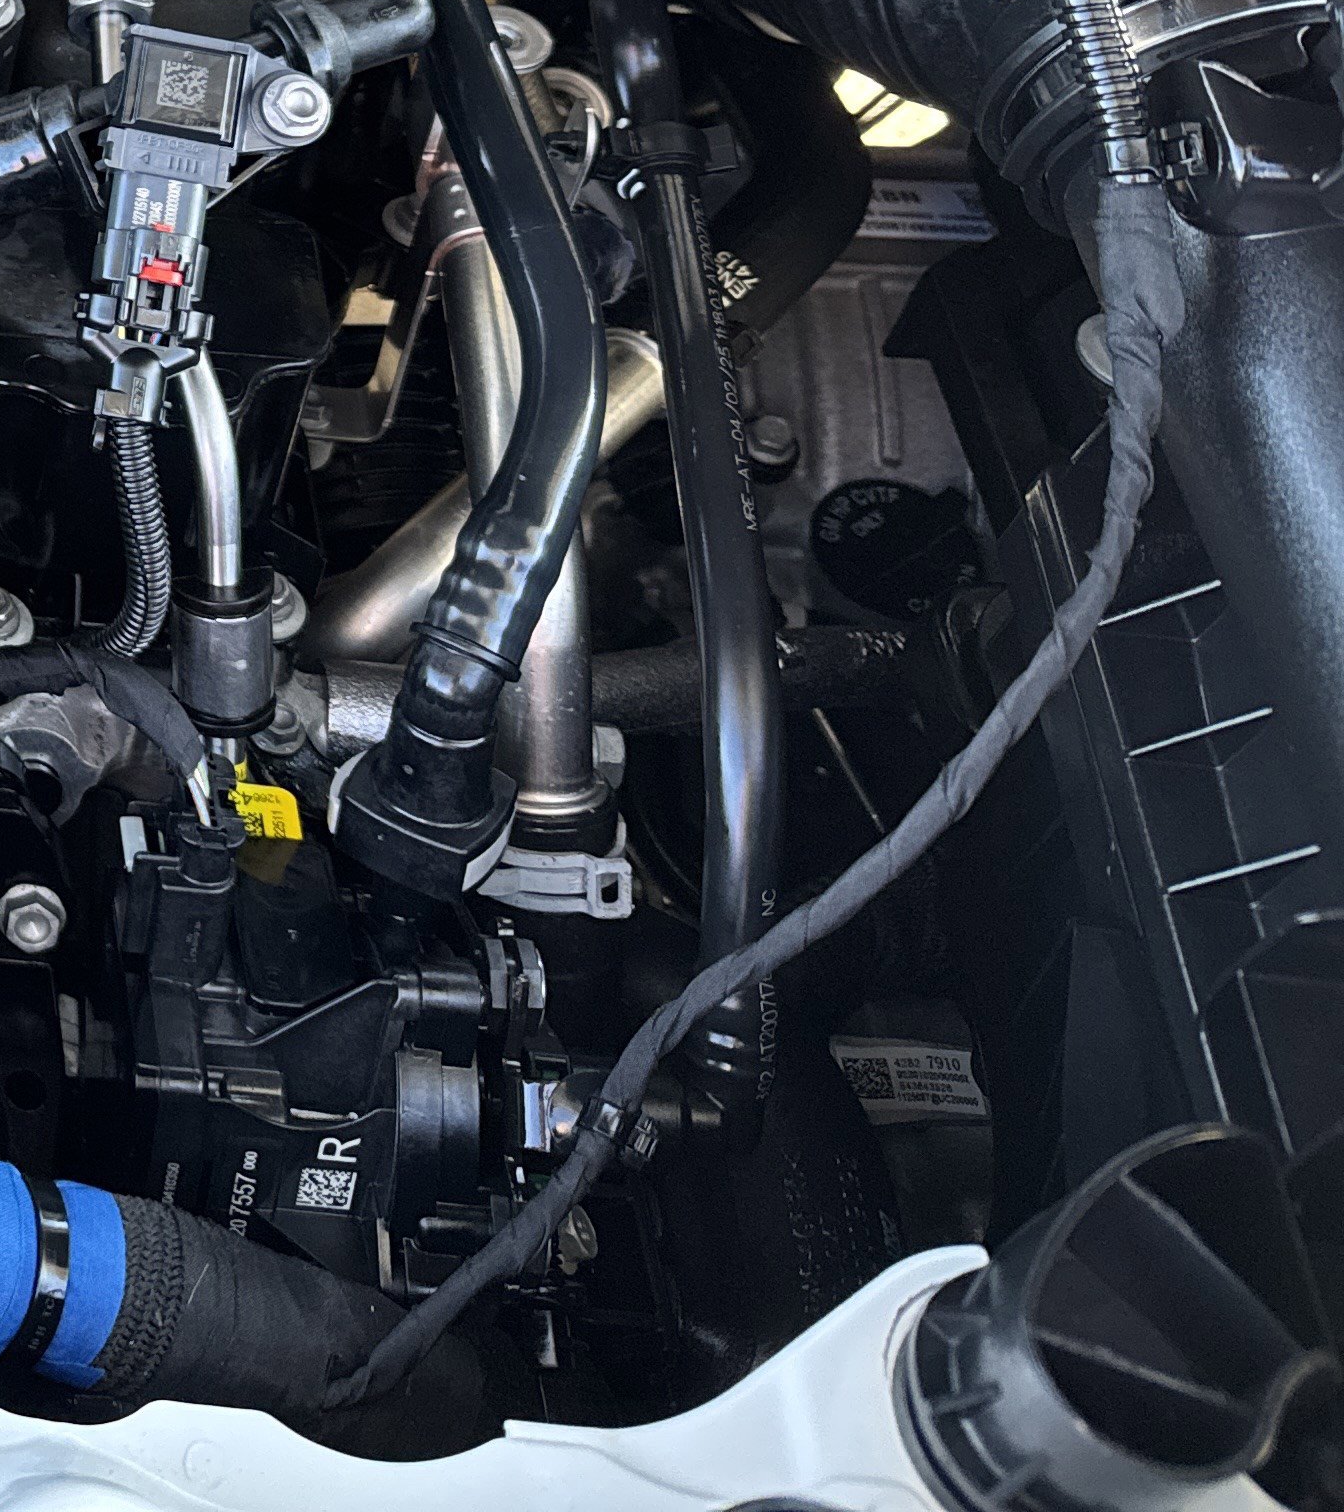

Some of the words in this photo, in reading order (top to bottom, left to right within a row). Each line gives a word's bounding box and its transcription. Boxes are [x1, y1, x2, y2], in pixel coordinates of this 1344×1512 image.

[925, 1055, 961, 1072] 7910
[242, 1150, 258, 1171] 000
[317, 1137, 362, 1163] R
[229, 1172, 258, 1218] 7557
